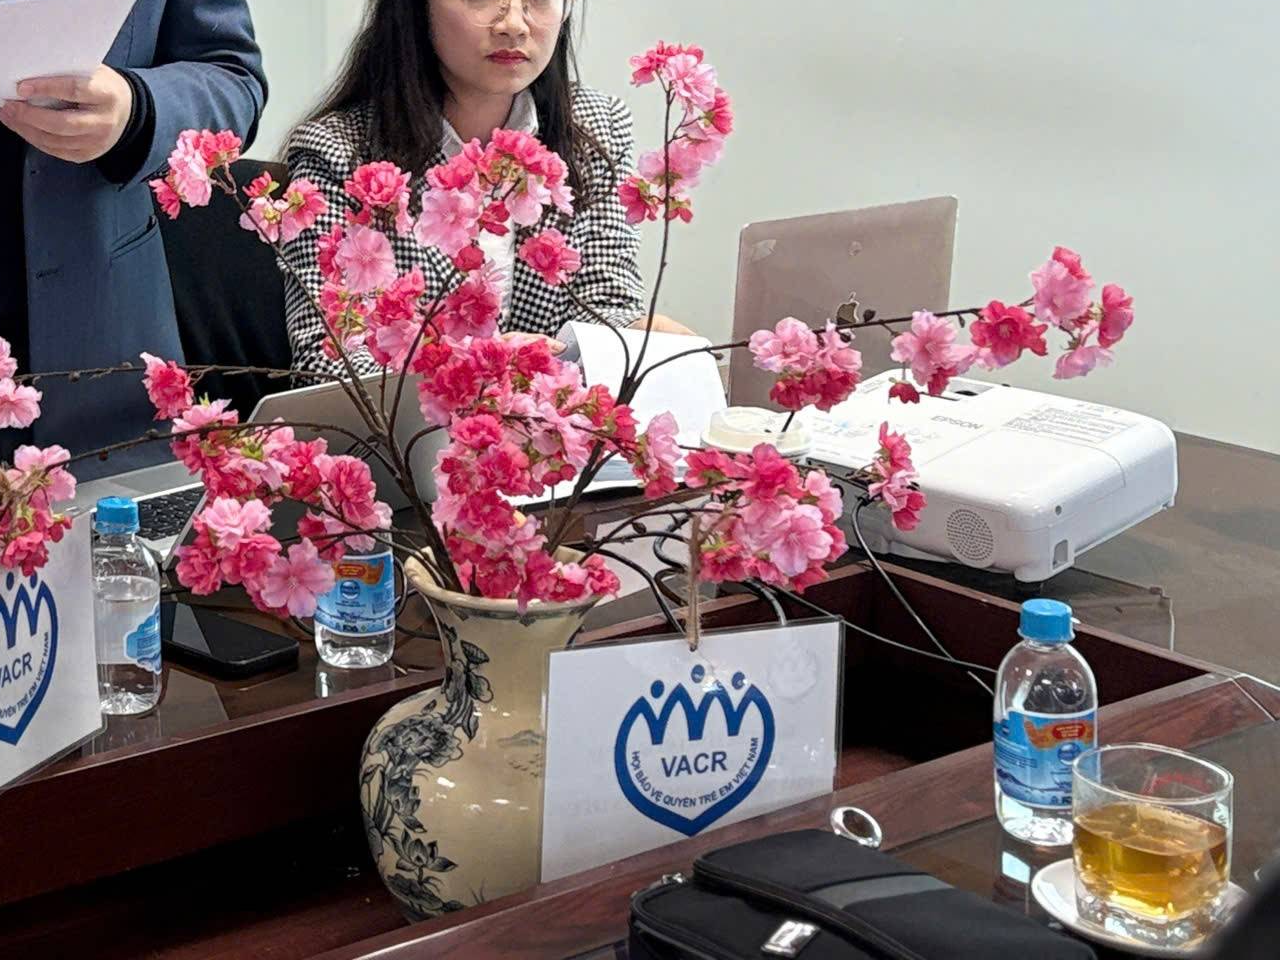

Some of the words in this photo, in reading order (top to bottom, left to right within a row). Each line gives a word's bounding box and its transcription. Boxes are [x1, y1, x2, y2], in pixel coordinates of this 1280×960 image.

[930, 415, 984, 430] EPSON
[661, 751, 728, 778] VACR
[719, 782, 735, 798] EM
[748, 737, 759, 762] NAM
